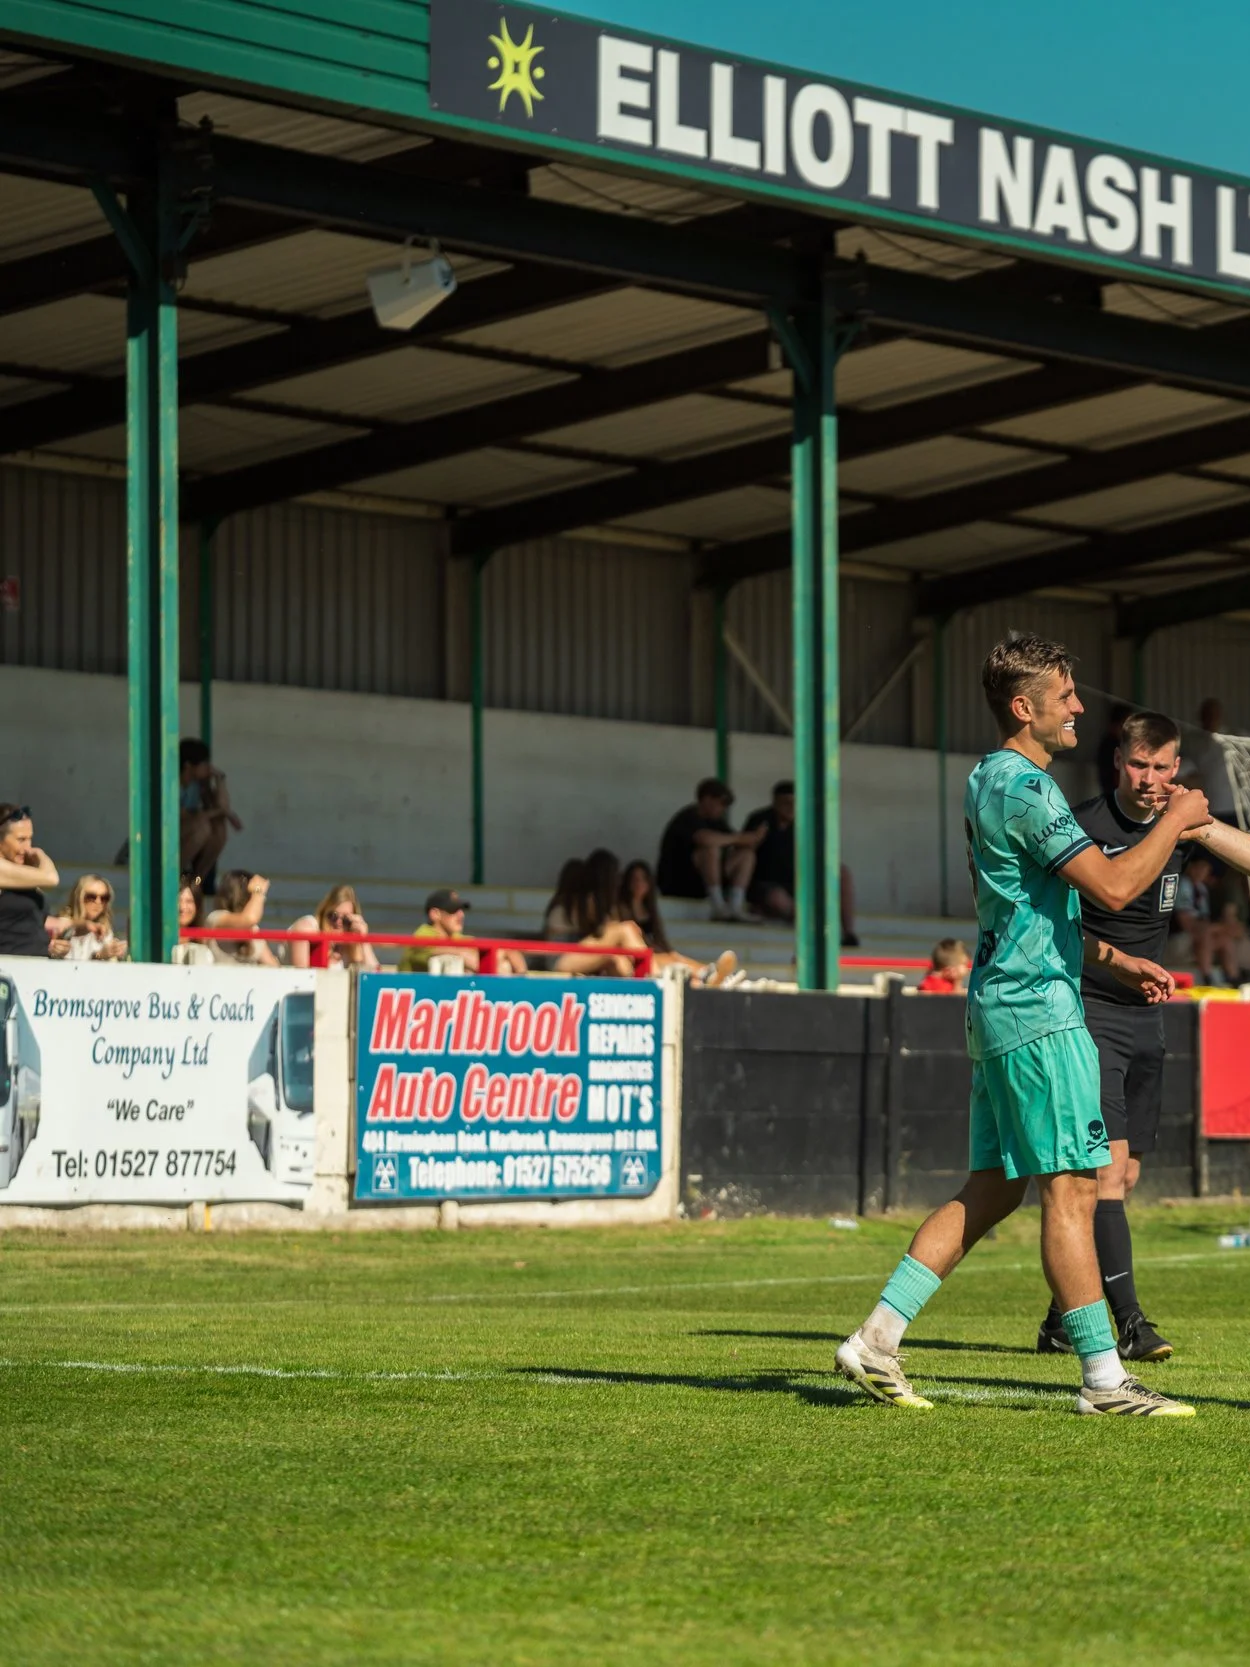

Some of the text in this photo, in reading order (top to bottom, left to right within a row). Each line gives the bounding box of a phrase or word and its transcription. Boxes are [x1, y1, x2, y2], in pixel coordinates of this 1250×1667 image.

[598, 34, 953, 210] ELLIOTT
[978, 126, 1193, 266] NASH
[33, 988, 255, 1032] Bromsgrove Bus & Coach
[369, 988, 585, 1057] Marlbrook
[92, 1032, 214, 1079] Company Ltd
[588, 1023, 655, 1056] REPAIRS
[366, 1063, 582, 1124] Auto Centre
[587, 1084, 654, 1123] MOT'S
[52, 1149, 236, 1178] Tel: 01527 877754
[408, 1156, 502, 1191] Telephone:
[503, 1154, 552, 1188] 01527
